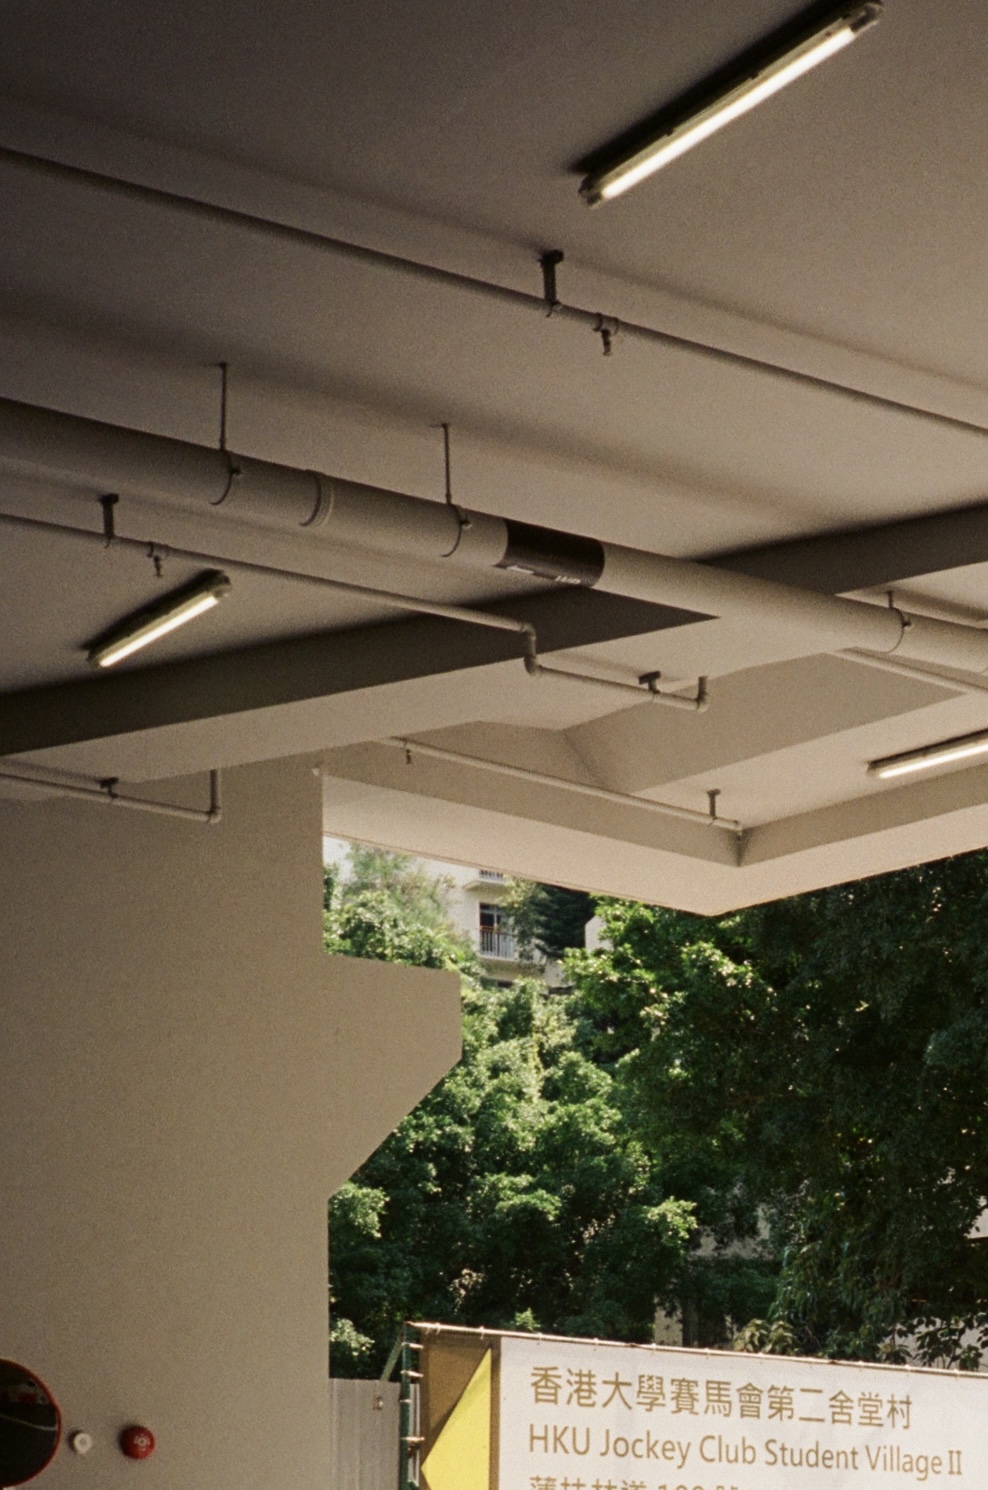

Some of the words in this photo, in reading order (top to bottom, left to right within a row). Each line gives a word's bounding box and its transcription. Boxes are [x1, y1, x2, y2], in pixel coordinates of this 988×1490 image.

[531, 1366, 912, 1430] 香港大學賽馬會第二舍堂村
[529, 1424, 591, 1455] HKU
[600, 1428, 692, 1469] Jockey
[700, 1435, 756, 1465] Club
[765, 1439, 858, 1470] Student
[866, 1445, 942, 1481] Village
[948, 1450, 962, 1475] II
